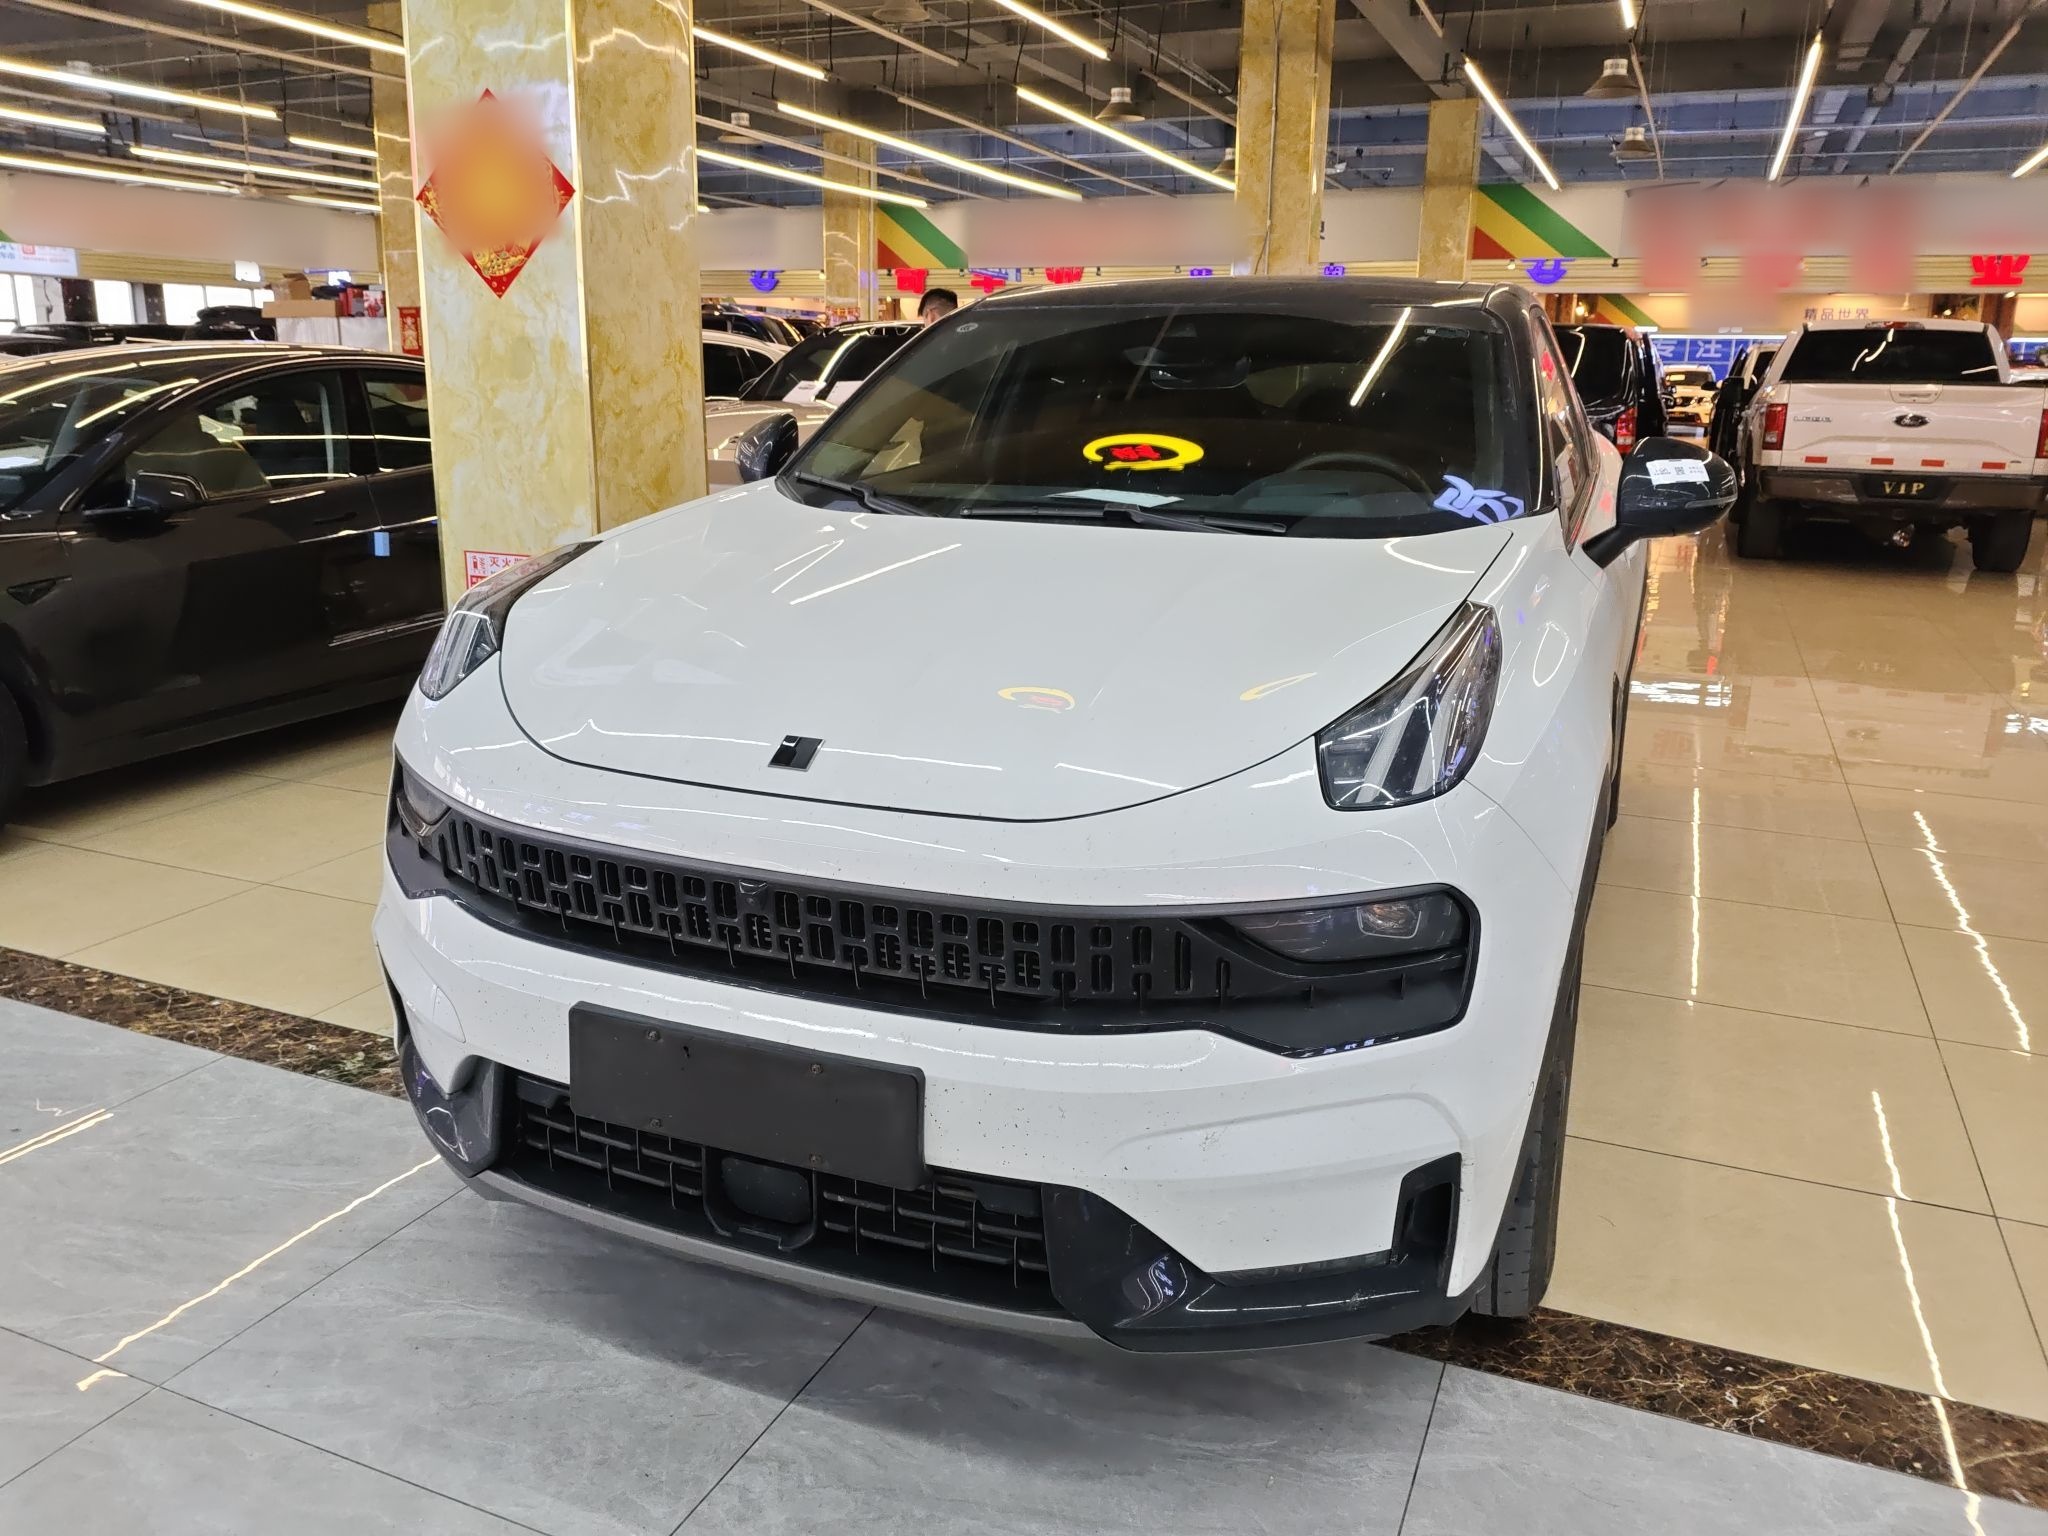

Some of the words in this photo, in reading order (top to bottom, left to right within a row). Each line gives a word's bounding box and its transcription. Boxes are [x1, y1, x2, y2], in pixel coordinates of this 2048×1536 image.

[1804, 308, 1869, 321] 精品世界
[1883, 481, 1925, 495] VIP
[490, 556, 524, 568] 灭火
